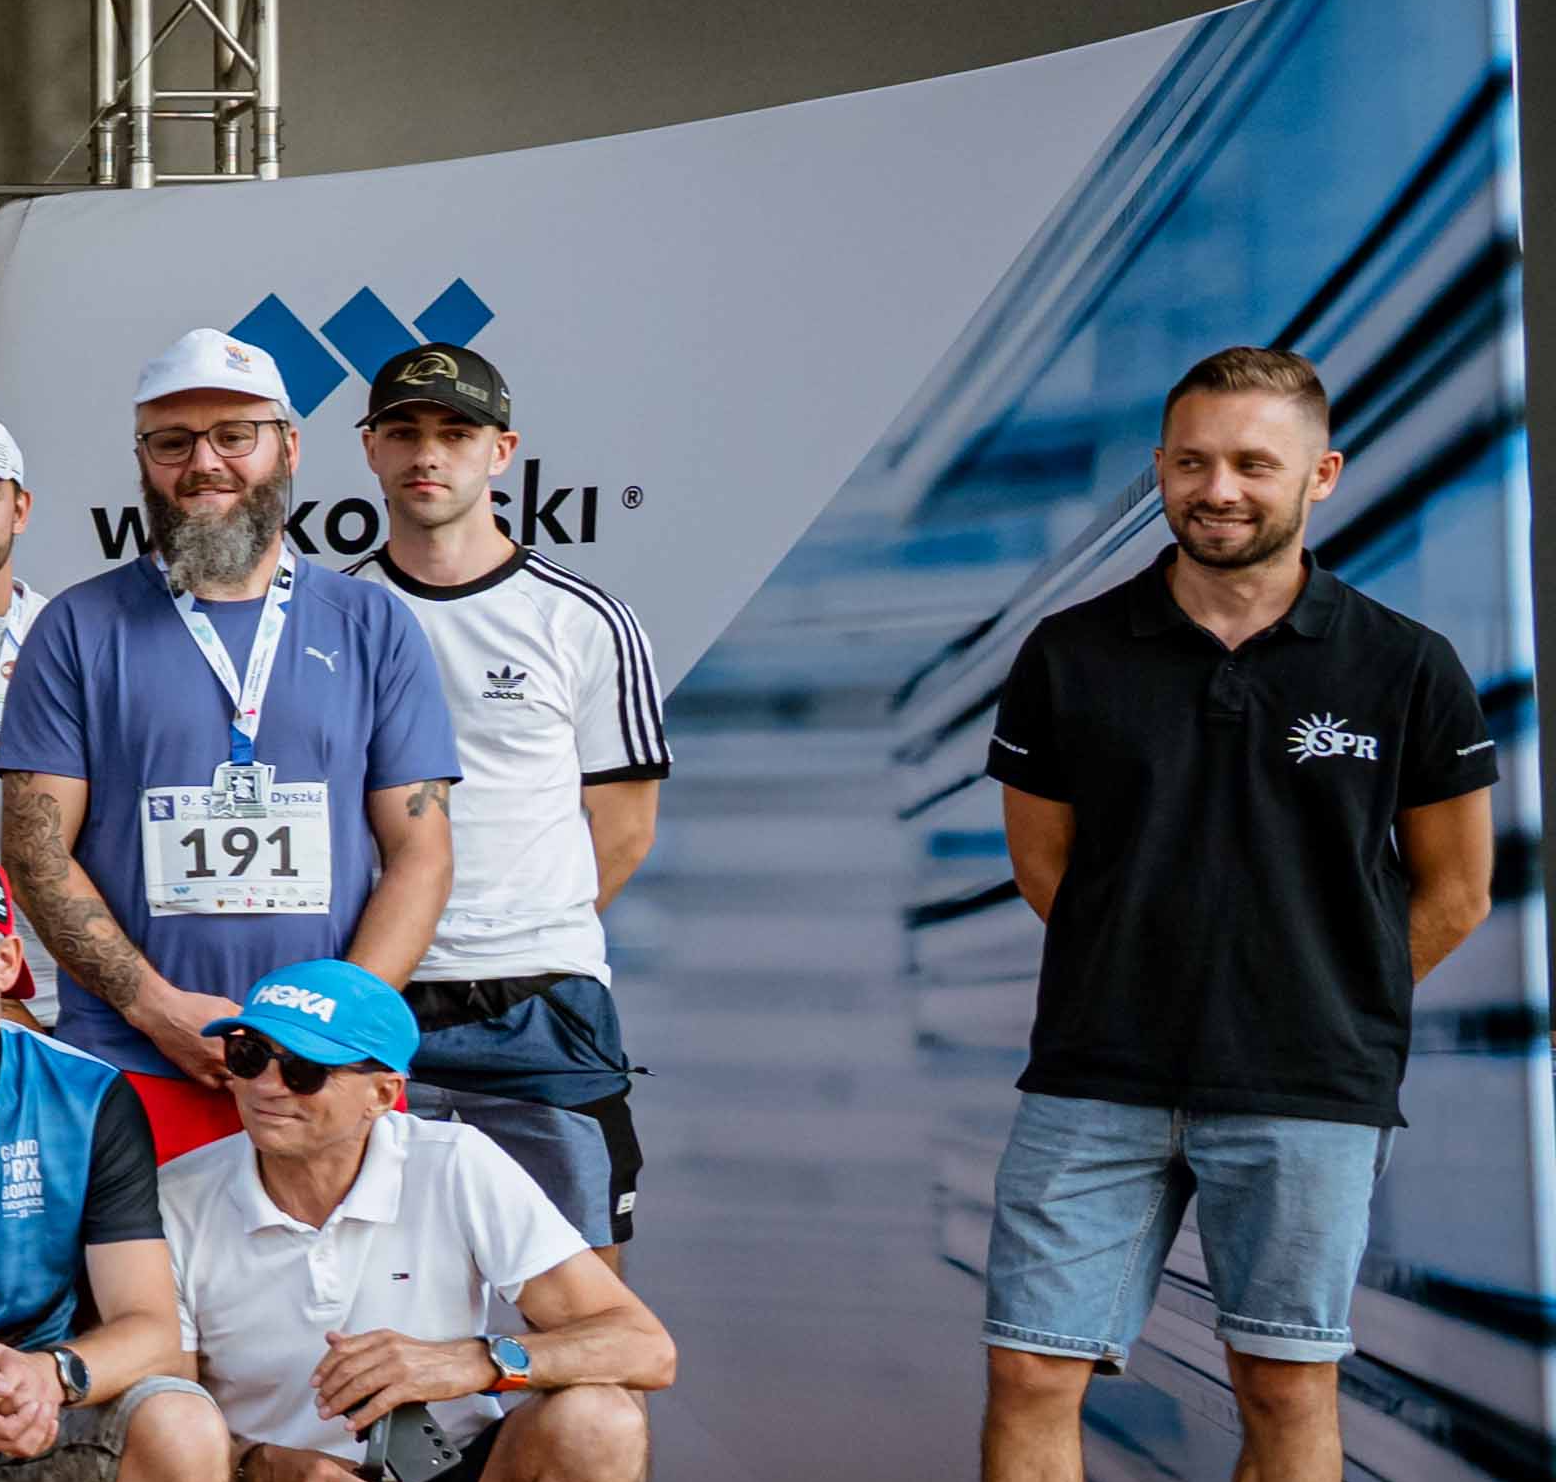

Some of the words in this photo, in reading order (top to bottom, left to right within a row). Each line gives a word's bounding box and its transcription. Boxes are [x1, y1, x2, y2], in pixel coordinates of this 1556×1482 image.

[482, 690, 525, 701] adidas
[1311, 726, 1379, 761] SPR
[180, 825, 300, 879] 191
[251, 984, 338, 1022] HOKA
